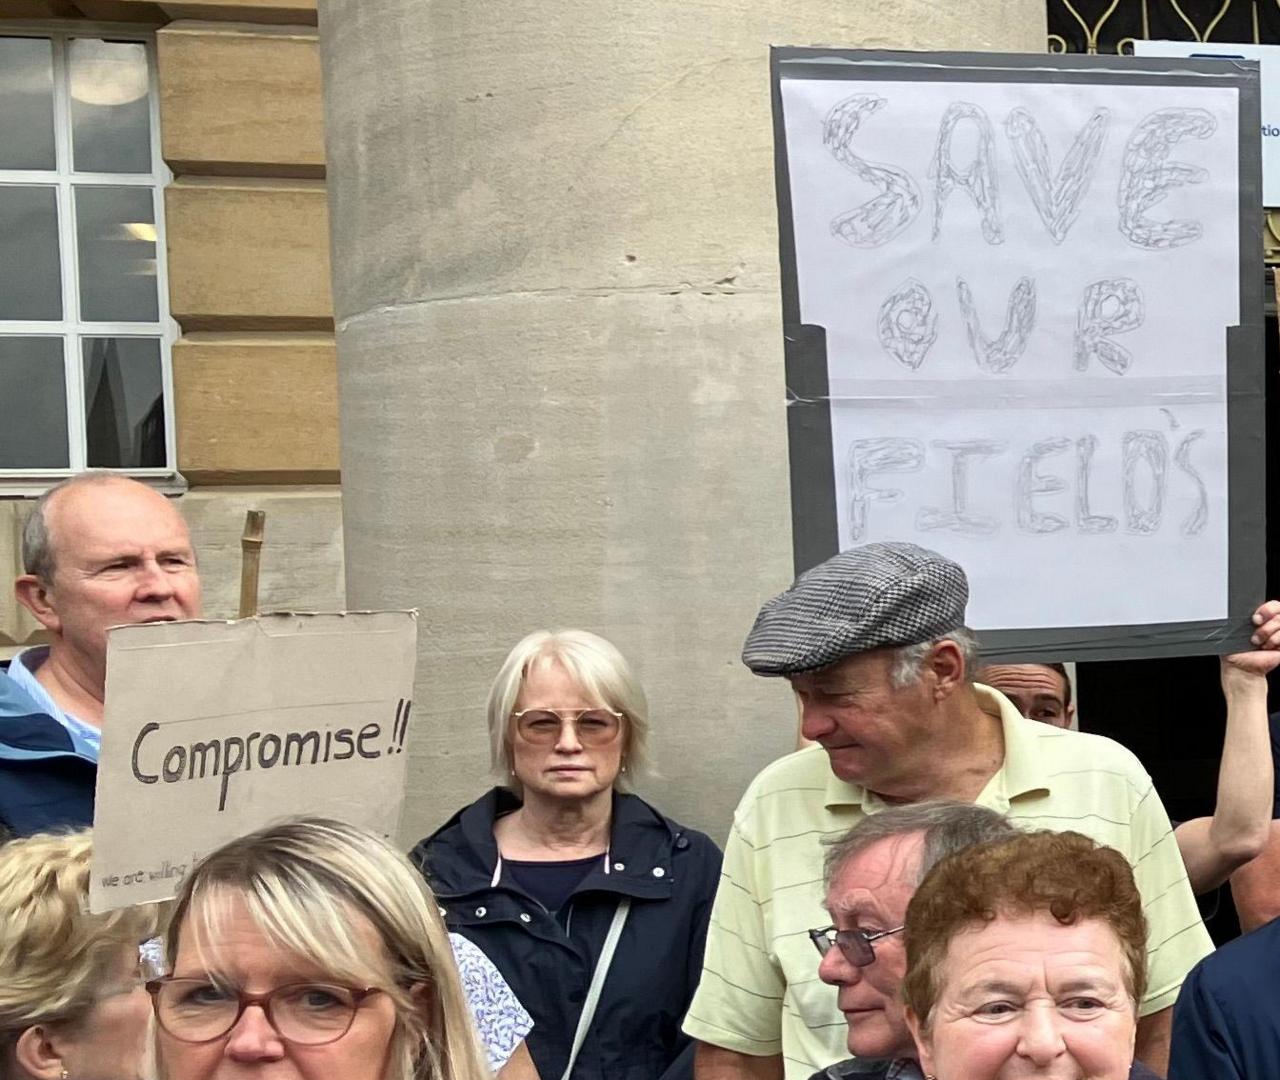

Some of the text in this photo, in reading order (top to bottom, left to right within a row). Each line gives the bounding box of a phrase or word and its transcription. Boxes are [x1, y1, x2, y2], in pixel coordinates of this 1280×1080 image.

[823, 93, 1217, 250] SAVE
[876, 275, 1145, 376] OUR
[131, 697, 412, 812] Compromise!!
